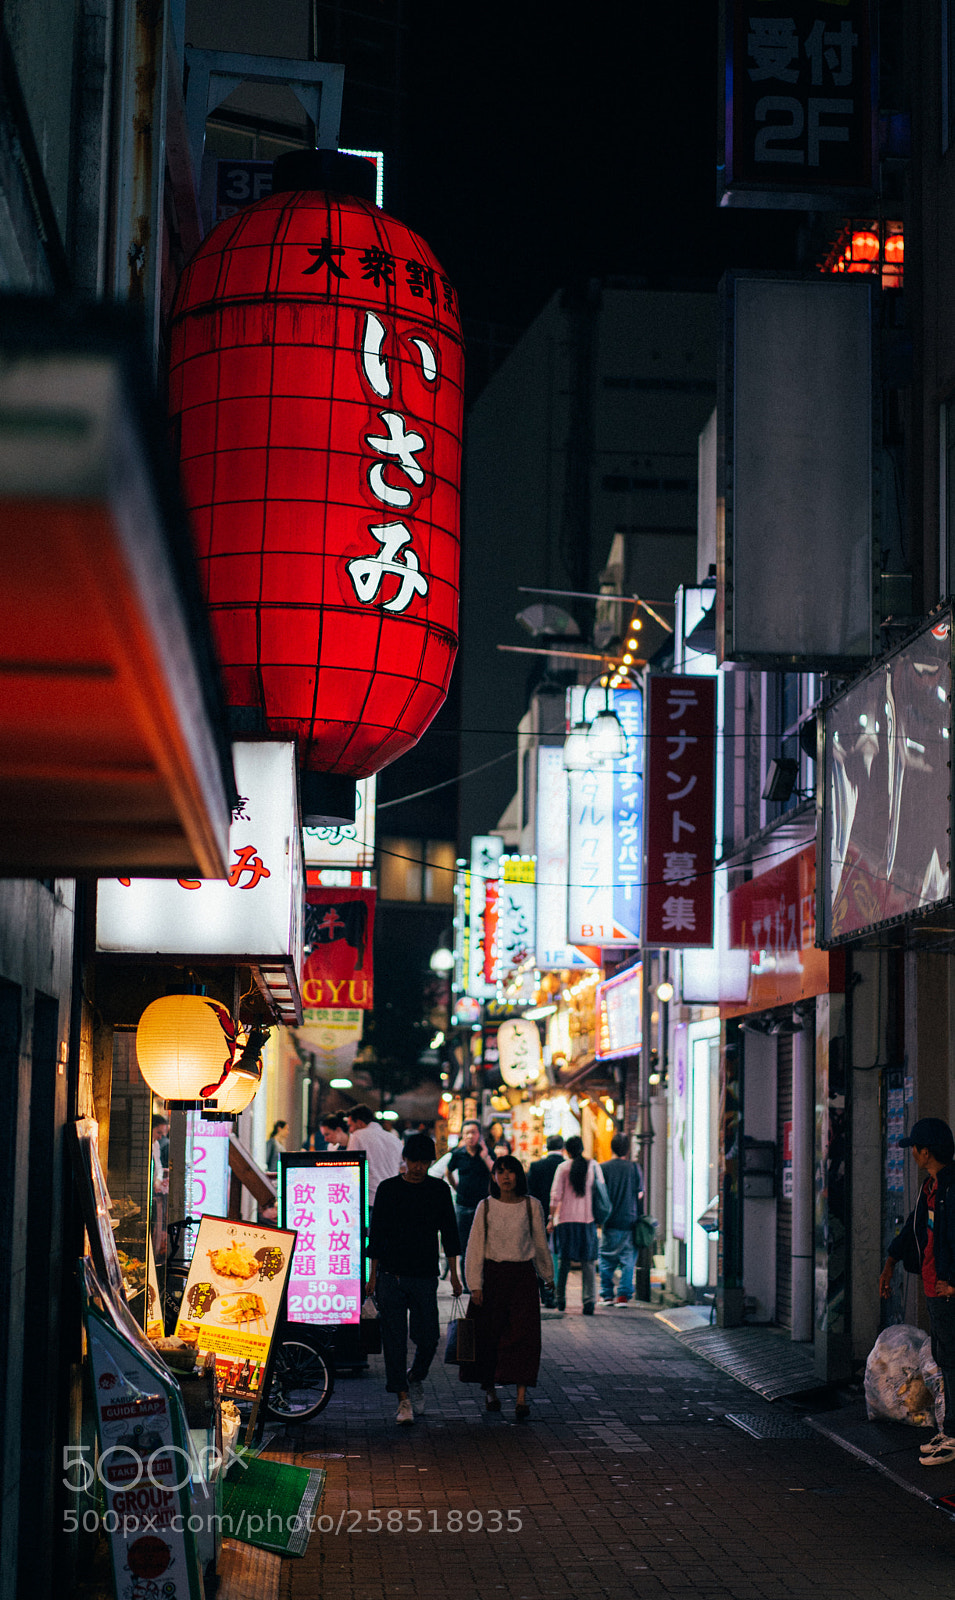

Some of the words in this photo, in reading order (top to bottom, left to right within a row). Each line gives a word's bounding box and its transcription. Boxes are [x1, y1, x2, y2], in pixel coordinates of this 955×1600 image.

[747, 17, 858, 86] 受付
[754, 96, 854, 166] 2F
[224, 169, 272, 199] 3F
[346, 311, 437, 614] いさみ
[662, 689, 698, 931] テナント募集
[318, 908, 345, 939] 牛
[580, 925, 605, 937] B1
[302, 978, 368, 1003] GYU
[293, 1182, 316, 1276] 飲み放題
[327, 1182, 351, 1276] 歌い放題
[308, 1281, 337, 1293] 50分
[289, 1294, 357, 1312] 2000円
[106, 1405, 137, 1419] GUIDE
[139, 1402, 161, 1414] MAP
[112, 1487, 174, 1513] GROUP
